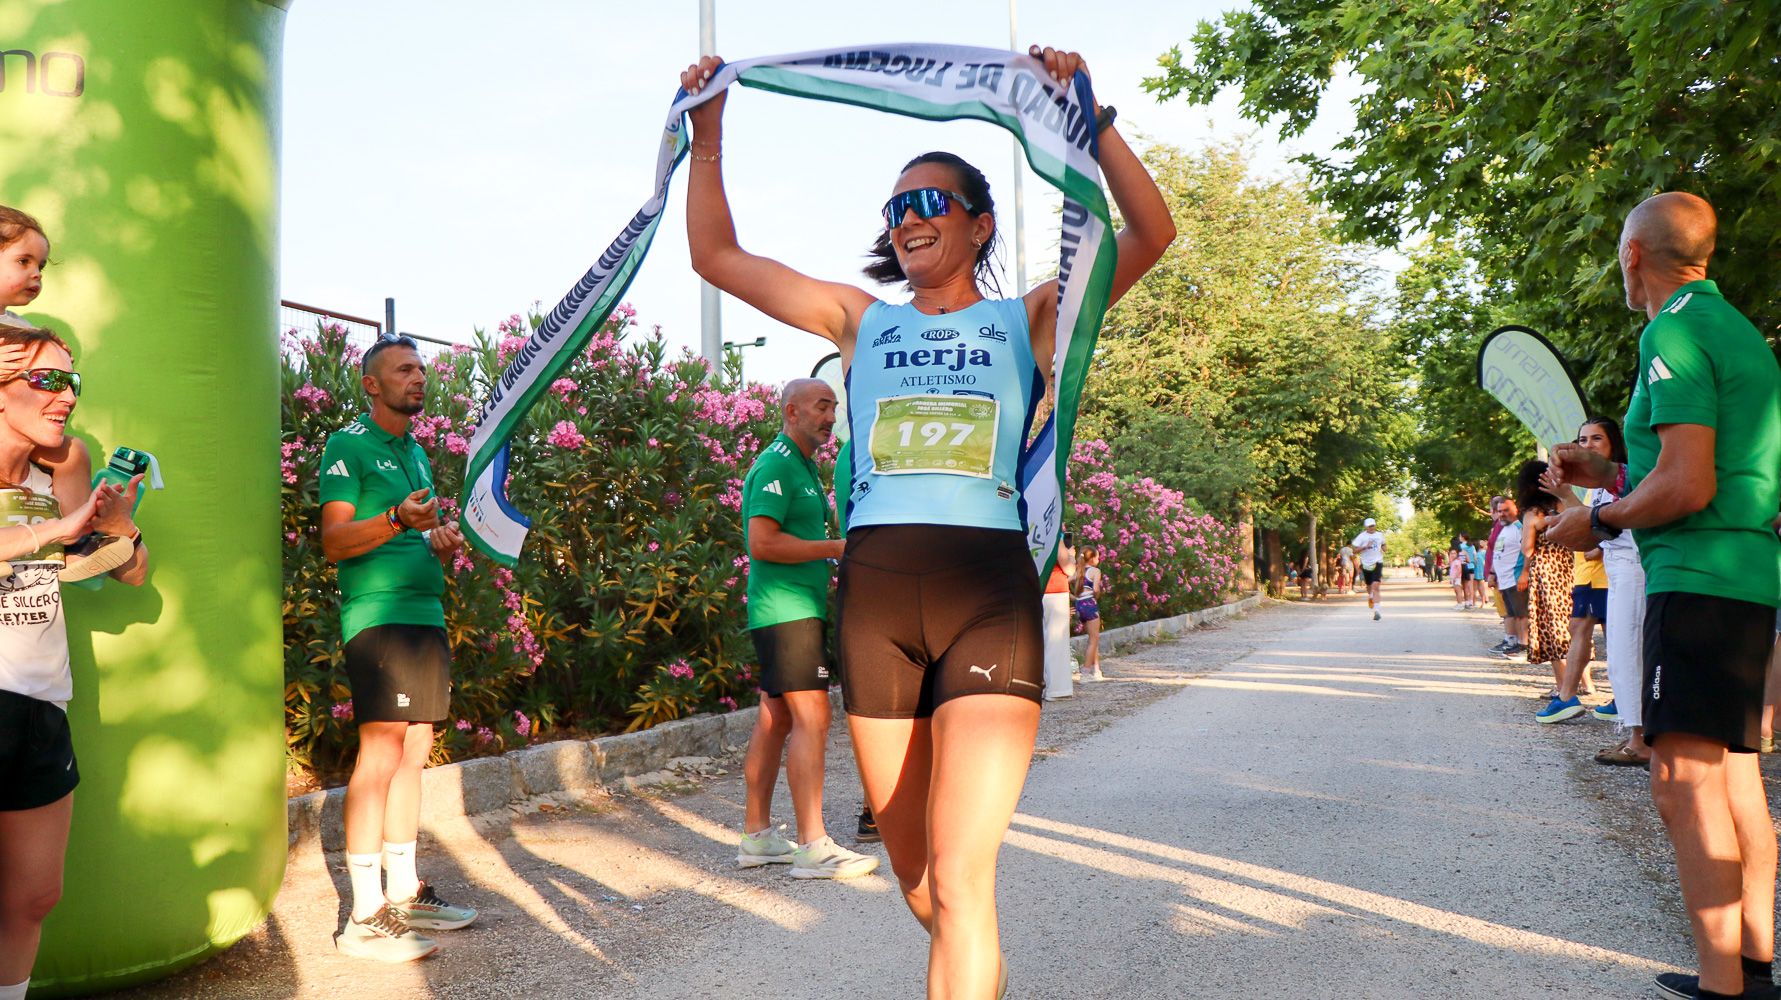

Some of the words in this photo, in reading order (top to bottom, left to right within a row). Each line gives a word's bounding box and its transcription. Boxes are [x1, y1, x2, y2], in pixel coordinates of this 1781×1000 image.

[923, 329, 959, 340] TROPS
[884, 343, 992, 371] nerja
[900, 374, 976, 387] ATLETISMO
[899, 421, 975, 447] 197
[13, 591, 60, 607] SILLERO
[1653, 665, 1661, 700] adidas
